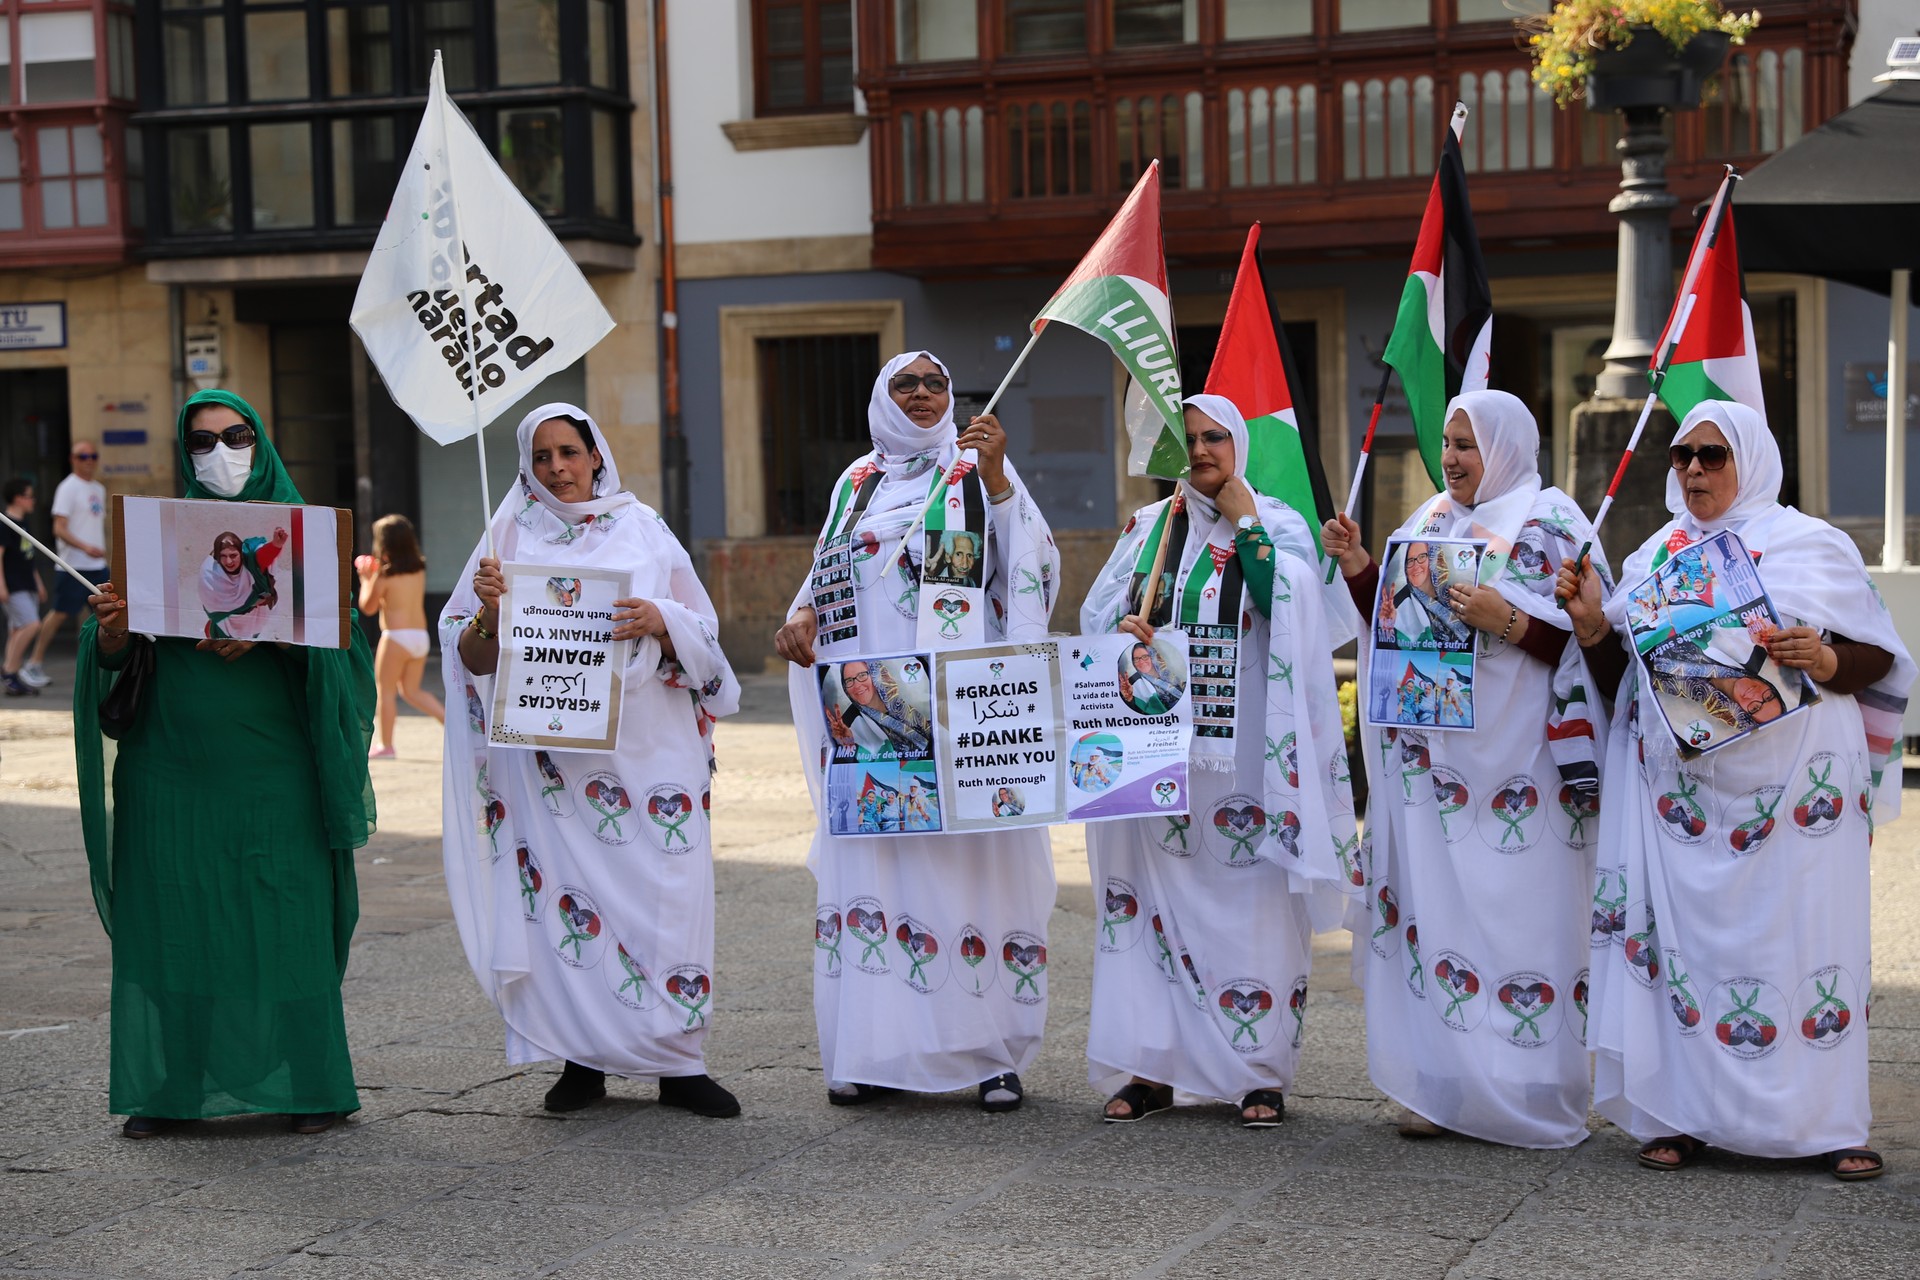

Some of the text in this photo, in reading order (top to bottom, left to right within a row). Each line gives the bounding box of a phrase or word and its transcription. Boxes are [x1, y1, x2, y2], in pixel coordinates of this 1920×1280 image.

[463, 240, 554, 371] rtad
[433, 289, 506, 389] ueblo
[522, 605, 612, 620] Ruth McDonough
[513, 626, 612, 643] #THANK YOU
[1649, 613, 1738, 661] Mujer debe sufrir
[1422, 640, 1444, 648] debe
[1445, 641, 1469, 650] sufrir
[523, 646, 606, 667] #DANKE
[955, 681, 1038, 700] #GRACIAS
[1074, 680, 1115, 689] #Salvamos
[518, 694, 601, 713] #GRACIAS
[1072, 690, 1118, 700] La vida de la
[1080, 702, 1114, 711] Activista
[1072, 715, 1102, 730] Ruth
[1105, 713, 1180, 728] McDonough
[957, 727, 1044, 749] #DANKE
[882, 750, 903, 759] debe
[904, 749, 929, 758] sufrir
[954, 750, 1056, 769] #THANK YOU
[958, 774, 1046, 788] Ruth McDonough
